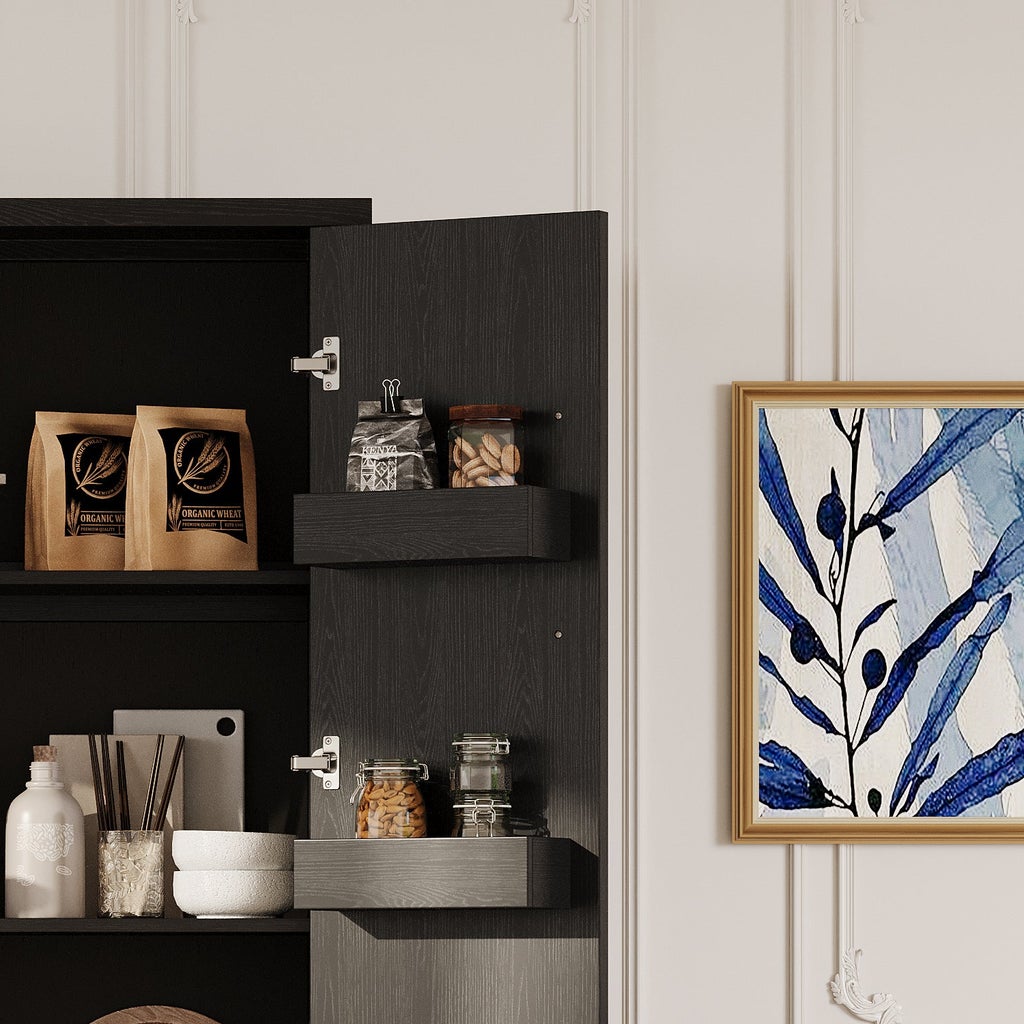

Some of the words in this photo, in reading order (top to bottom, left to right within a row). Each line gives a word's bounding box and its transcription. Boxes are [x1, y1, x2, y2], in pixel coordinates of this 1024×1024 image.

[80, 513, 114, 523] ORGANIC
[181, 509, 216, 518] ORGANIC
[216, 509, 242, 519] WHEAT
